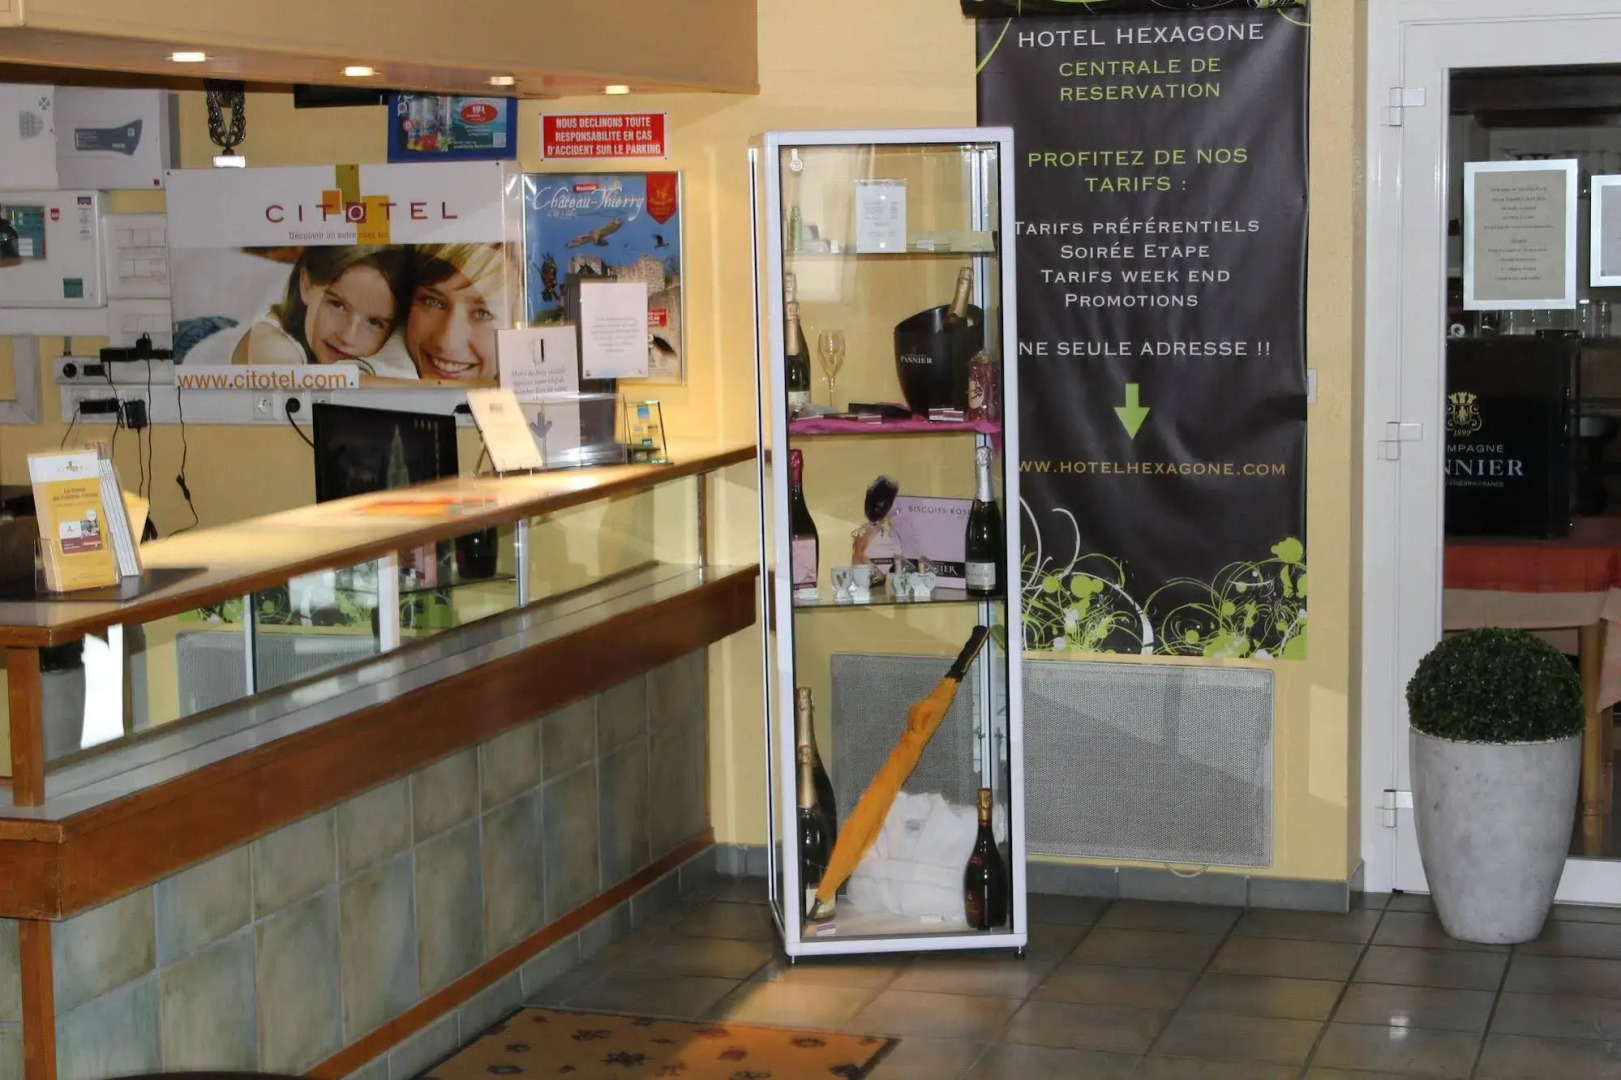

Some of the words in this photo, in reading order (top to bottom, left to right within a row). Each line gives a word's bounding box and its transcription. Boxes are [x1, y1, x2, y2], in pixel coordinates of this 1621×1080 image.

[1018, 29, 1106, 48] HOTEL
[1116, 23, 1264, 45] HEXAGONE
[1059, 59, 1181, 77] CENTRALE
[1190, 58, 1221, 73] DE
[1060, 83, 1220, 101] RESERVATION
[556, 118, 577, 128] NOUS
[579, 117, 623, 128] DECLINONS
[625, 116, 651, 127] TOUTE
[555, 131, 621, 142] RESPONSABILITE
[623, 131, 634, 141] EN
[636, 130, 652, 140] CAS
[547, 145, 594, 156] D'ACCIDENT
[595, 145, 612, 155] SUR
[613, 144, 624, 154] LE
[626, 144, 661, 155] PARKING
[1028, 151, 1145, 167] PROFITEZ
[1154, 150, 1186, 165] DE
[1197, 148, 1248, 164] NOS
[1085, 176, 1171, 192] TARIFS
[265, 201, 458, 224] CITOTEL
[532, 186, 644, 222] Château-Thierry
[1015, 221, 1084, 235] TARIFS
[1093, 217, 1260, 234] PRÉFÉRENTIELS
[1060, 241, 1134, 259] SOIRÉE
[1144, 244, 1209, 258] ETAPE
[1040, 269, 1113, 284] TARIFS
[1122, 270, 1179, 283] WEEK
[1188, 270, 1231, 282] END
[1065, 293, 1199, 308] PROMOTIONS
[1057, 341, 1132, 356] SEULE
[1140, 341, 1248, 356] ADRESSE
[177, 370, 347, 389] www.citotel.com
[1447, 444, 1504, 453] MPAGNE
[908, 505, 947, 514] BISCUITS
